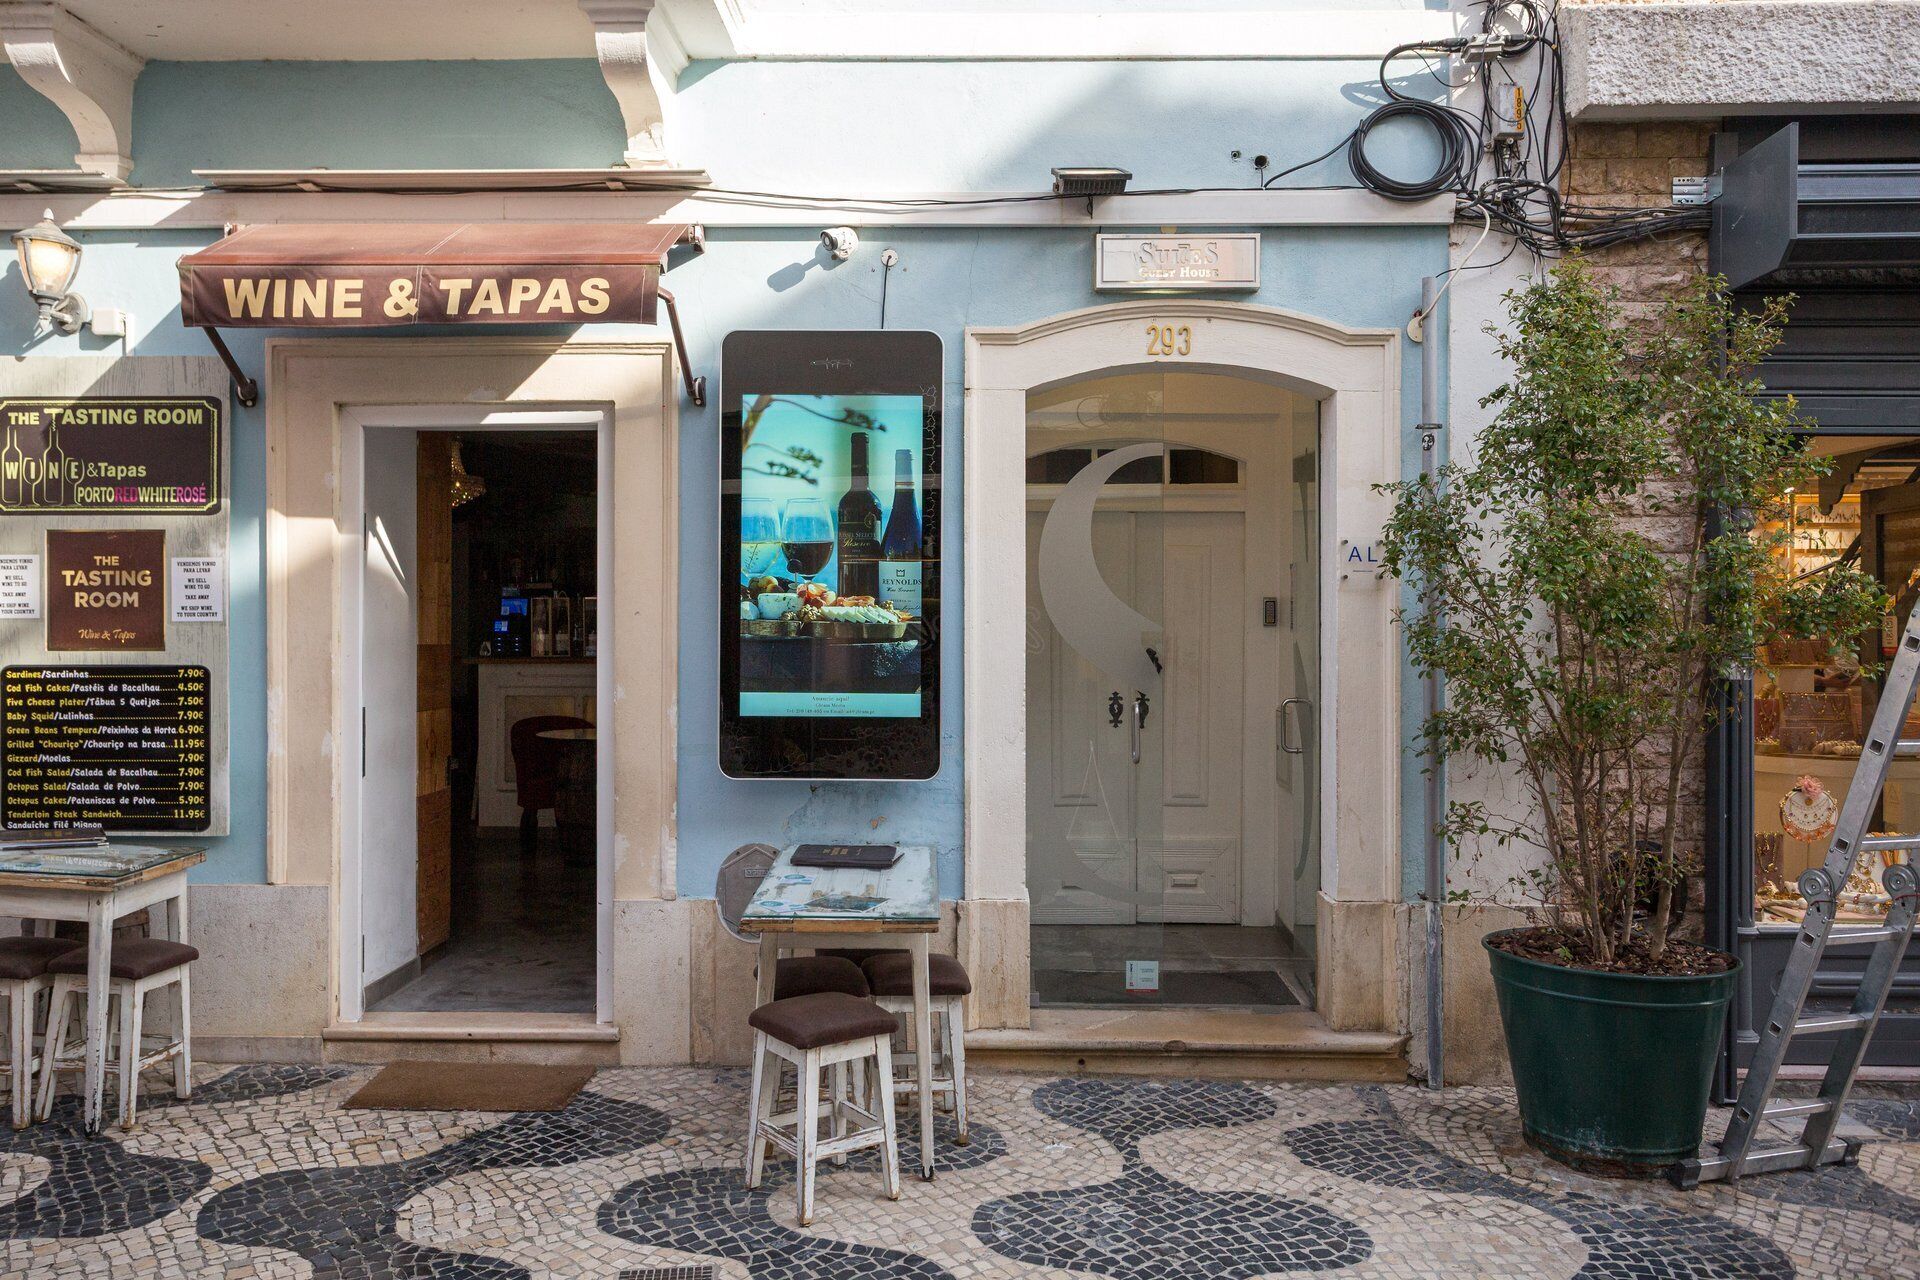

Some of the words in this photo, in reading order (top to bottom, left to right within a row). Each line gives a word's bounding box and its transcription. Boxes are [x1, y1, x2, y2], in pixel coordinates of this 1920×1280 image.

[223, 278, 363, 318] WINE
[383, 278, 419, 318] &
[439, 277, 610, 316] TAPAS
[1146, 324, 1192, 356] 293
[8, 412, 40, 425] THE
[44, 408, 137, 426] TASTING
[144, 408, 203, 424] ROOM
[1348, 546, 1378, 562] AL
[94, 556, 120, 566] THE
[62, 570, 152, 587] TASTING
[74, 592, 139, 608] ROOM
[178, 669, 204, 678] 7.90€
[28, 698, 56, 707] Cheese
[120, 698, 125, 707] 5
[130, 698, 160, 707] Queijos
[178, 697, 204, 705] 7.50€
[7, 712, 26, 721] Baby
[178, 711, 204, 720] 7.90€
[7, 726, 29, 735] Green
[34, 726, 57, 735] Beans
[142, 726, 151, 735] da
[154, 726, 176, 735] Horta
[7, 740, 34, 750] Grilled
[128, 740, 138, 750] na
[142, 740, 165, 750] brasa
[174, 740, 204, 748] 11.95€
[178, 754, 204, 762] 7.90€
[178, 768, 204, 776] 7.90€
[8, 782, 39, 791] Octopus
[104, 782, 113, 791] de
[117, 782, 140, 791] Polvo
[178, 782, 204, 790] 7.90€
[8, 797, 39, 805] Octopus
[120, 797, 129, 805] de
[133, 797, 156, 805] Polvo
[179, 796, 204, 804] 5.90€
[174, 810, 205, 818] 11.95€
